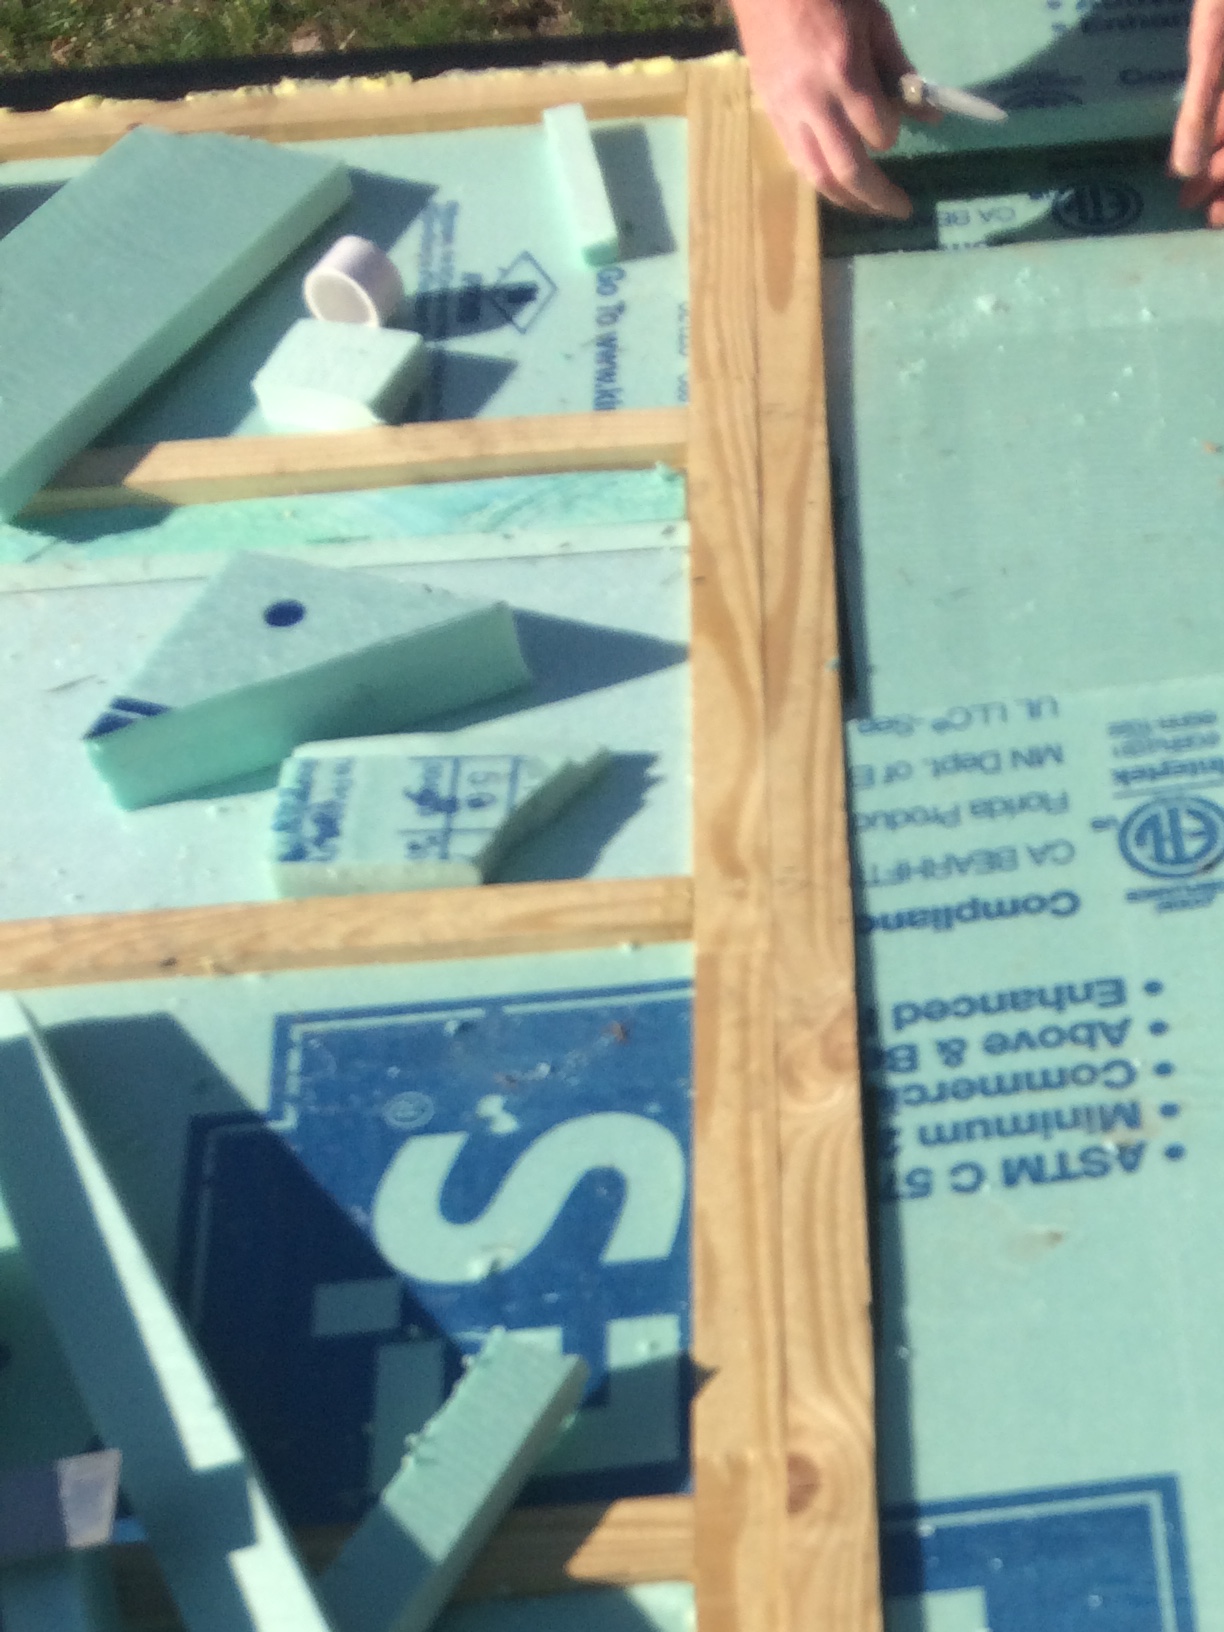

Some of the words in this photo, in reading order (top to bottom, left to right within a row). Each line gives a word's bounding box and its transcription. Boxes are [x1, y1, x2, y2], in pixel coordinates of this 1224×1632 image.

[596, 267, 628, 297] Go
[1009, 744, 1060, 772] MN
[966, 790, 1066, 828] Florida
[1027, 838, 1073, 871] CA
[892, 976, 1125, 1031] Enhanced
[937, 1037, 966, 1067] &
[982, 1015, 1130, 1058] Above
[917, 1099, 1141, 1149] Minimum
[949, 1160, 988, 1195] C
[1000, 1140, 1146, 1186] ASTM
